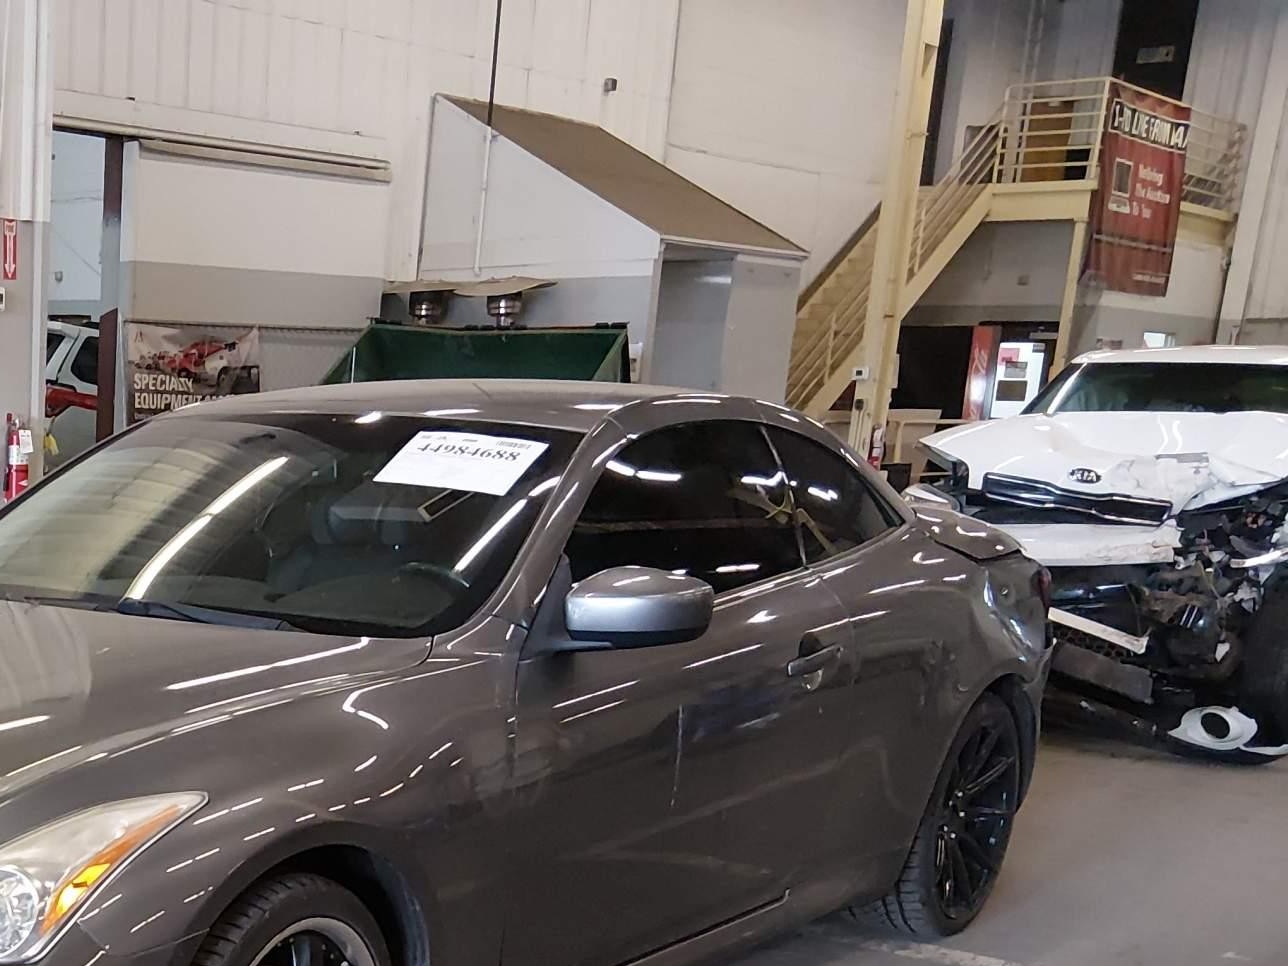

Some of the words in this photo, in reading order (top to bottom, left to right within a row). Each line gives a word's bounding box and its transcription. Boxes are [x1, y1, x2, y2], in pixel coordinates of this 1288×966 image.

[133, 373, 194, 393] SPECIALTY
[417, 443, 521, 461] 44984688
[1073, 470, 1097, 482] KIA
